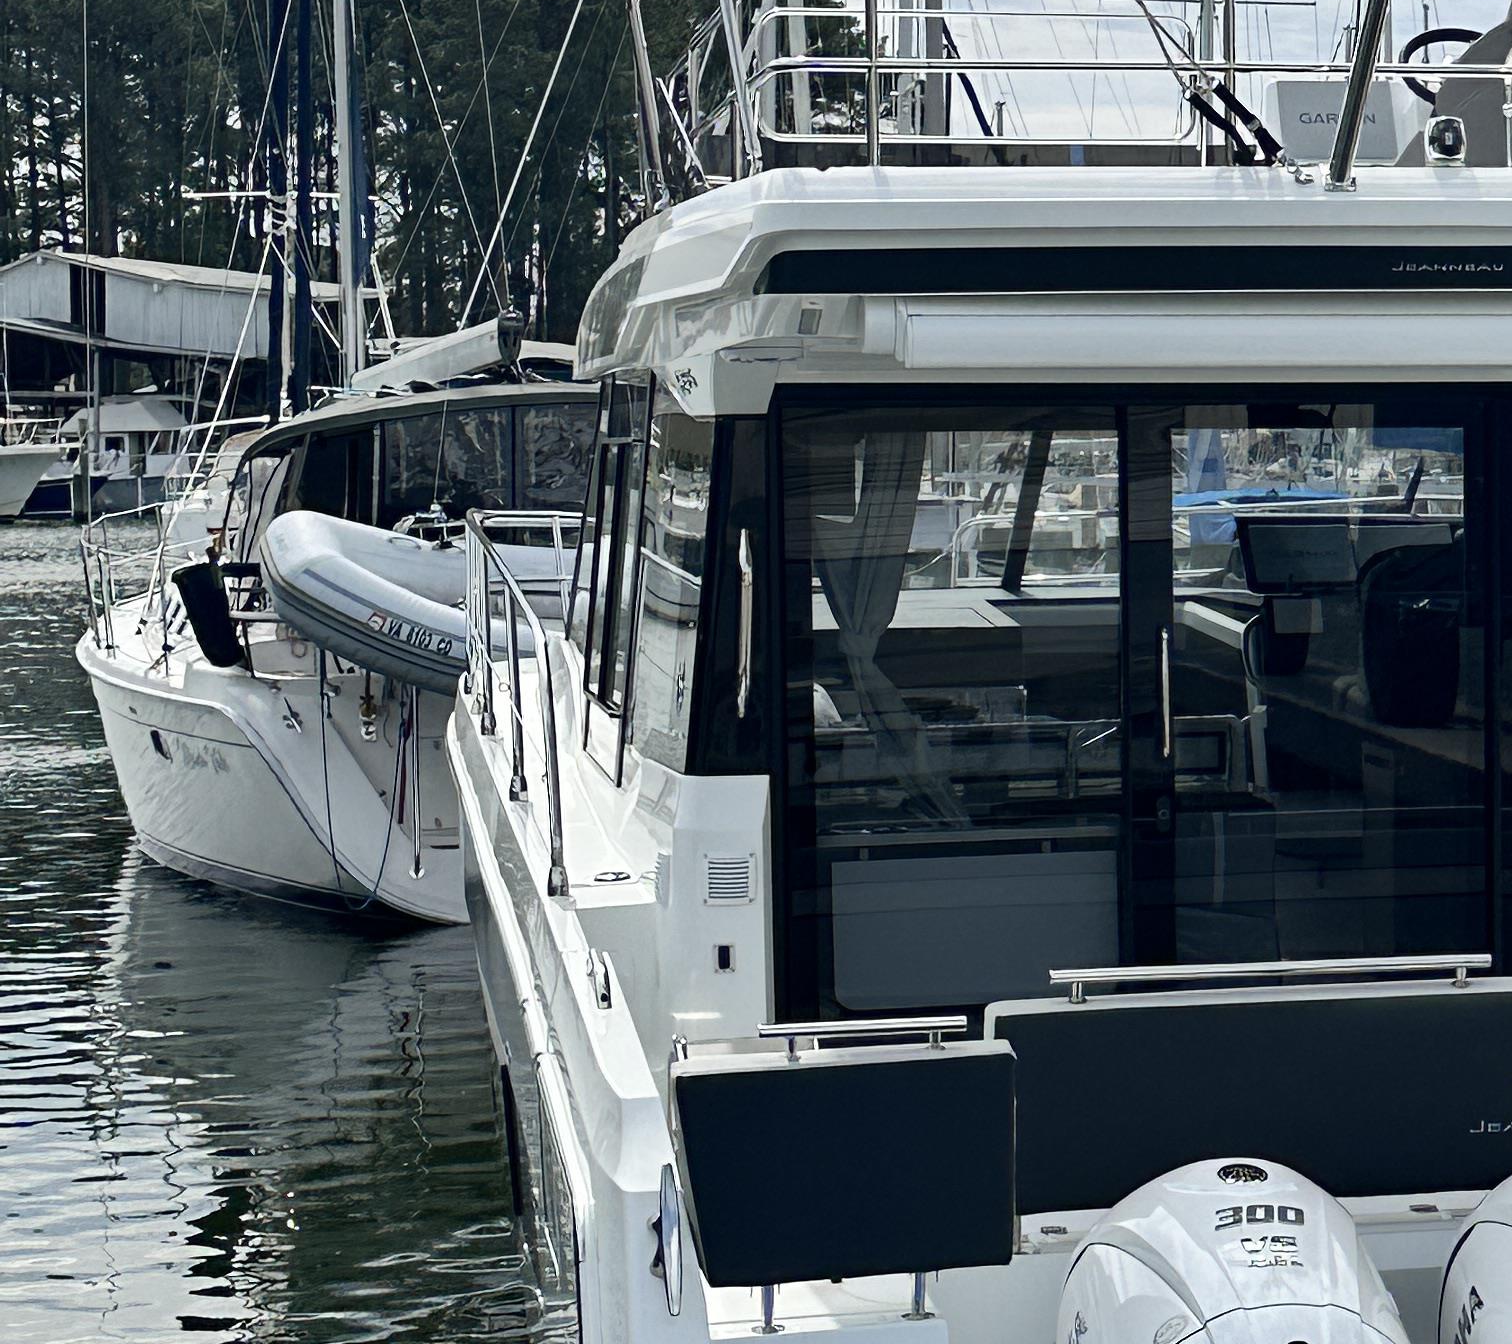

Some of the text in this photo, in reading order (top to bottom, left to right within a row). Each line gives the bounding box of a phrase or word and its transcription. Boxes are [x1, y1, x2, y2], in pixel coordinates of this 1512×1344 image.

[1299, 112, 1376, 124] GARN
[1391, 260, 1504, 272] JEANNEAU
[387, 618, 403, 640] VA
[1214, 1204, 1305, 1232] 300
